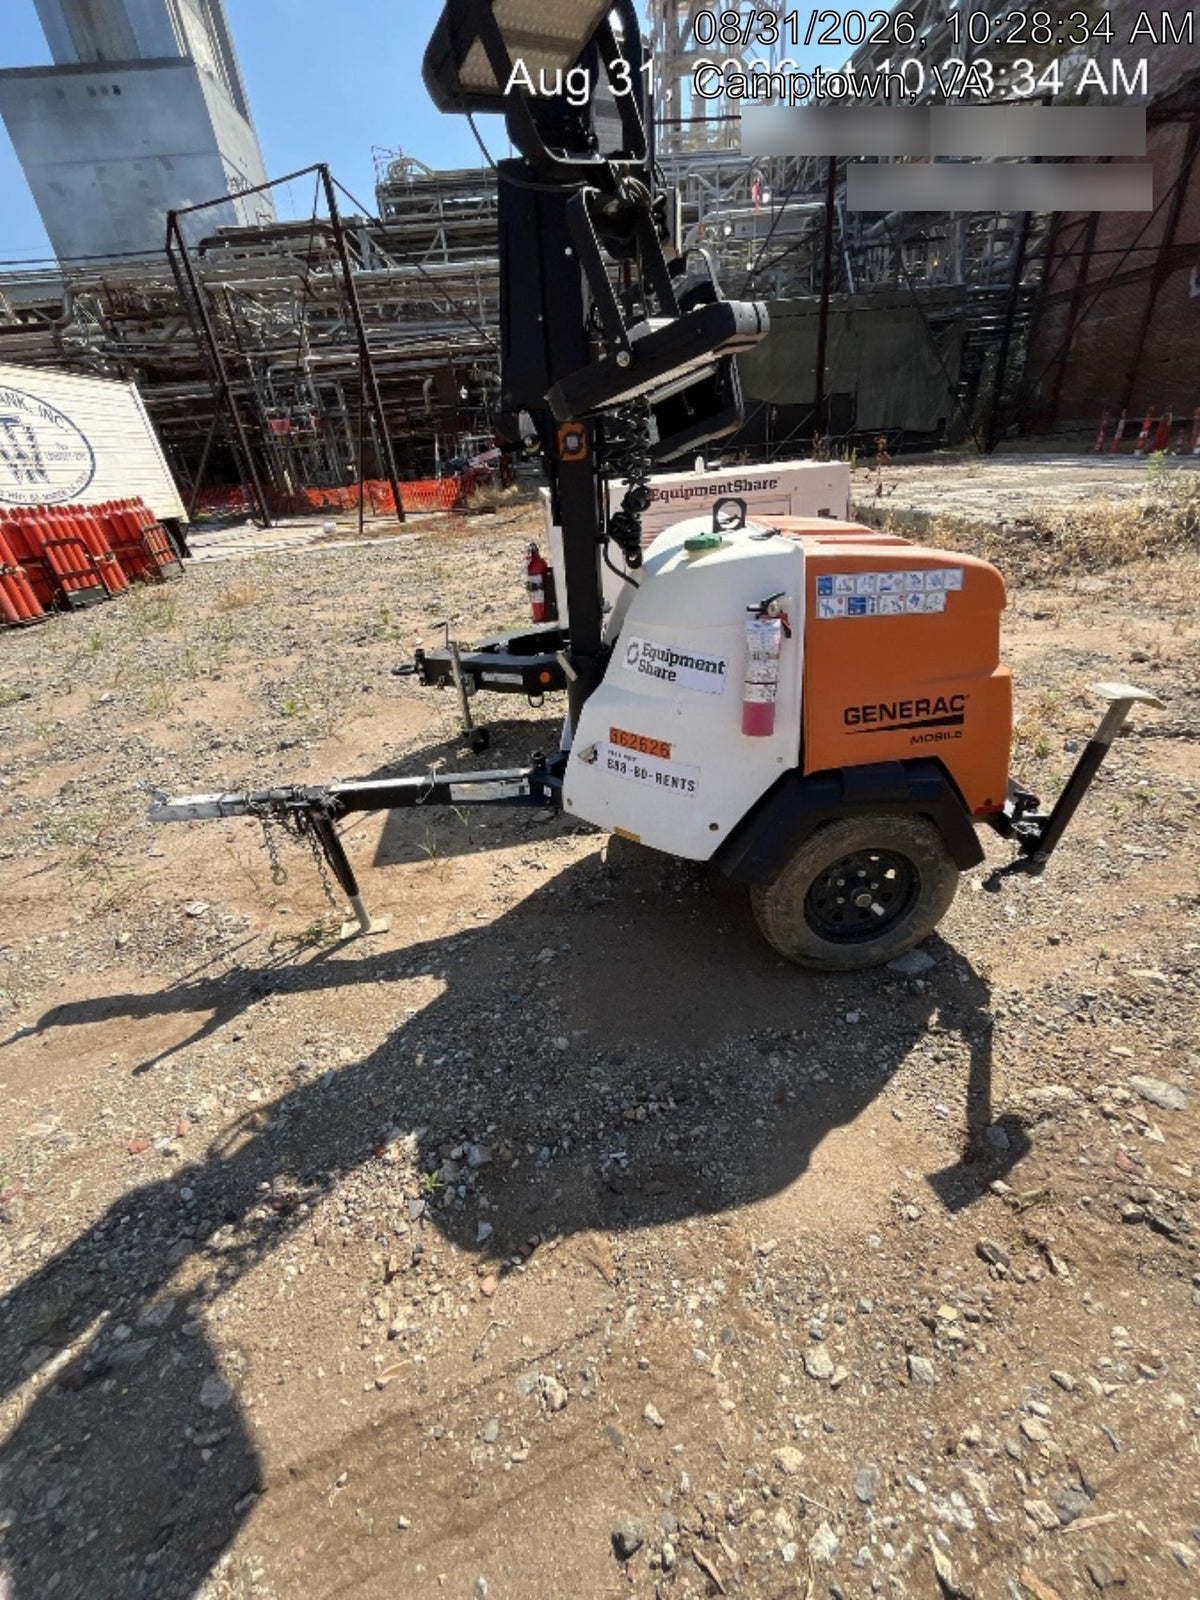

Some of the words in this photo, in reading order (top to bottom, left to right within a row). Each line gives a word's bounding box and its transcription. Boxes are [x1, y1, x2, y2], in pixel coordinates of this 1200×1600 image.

[650, 478, 779, 504] EquipmentShare
[637, 658, 677, 682] Share
[641, 642, 726, 675] Equipment
[843, 694, 966, 726] GENERAC
[910, 730, 963, 745] MOBILE
